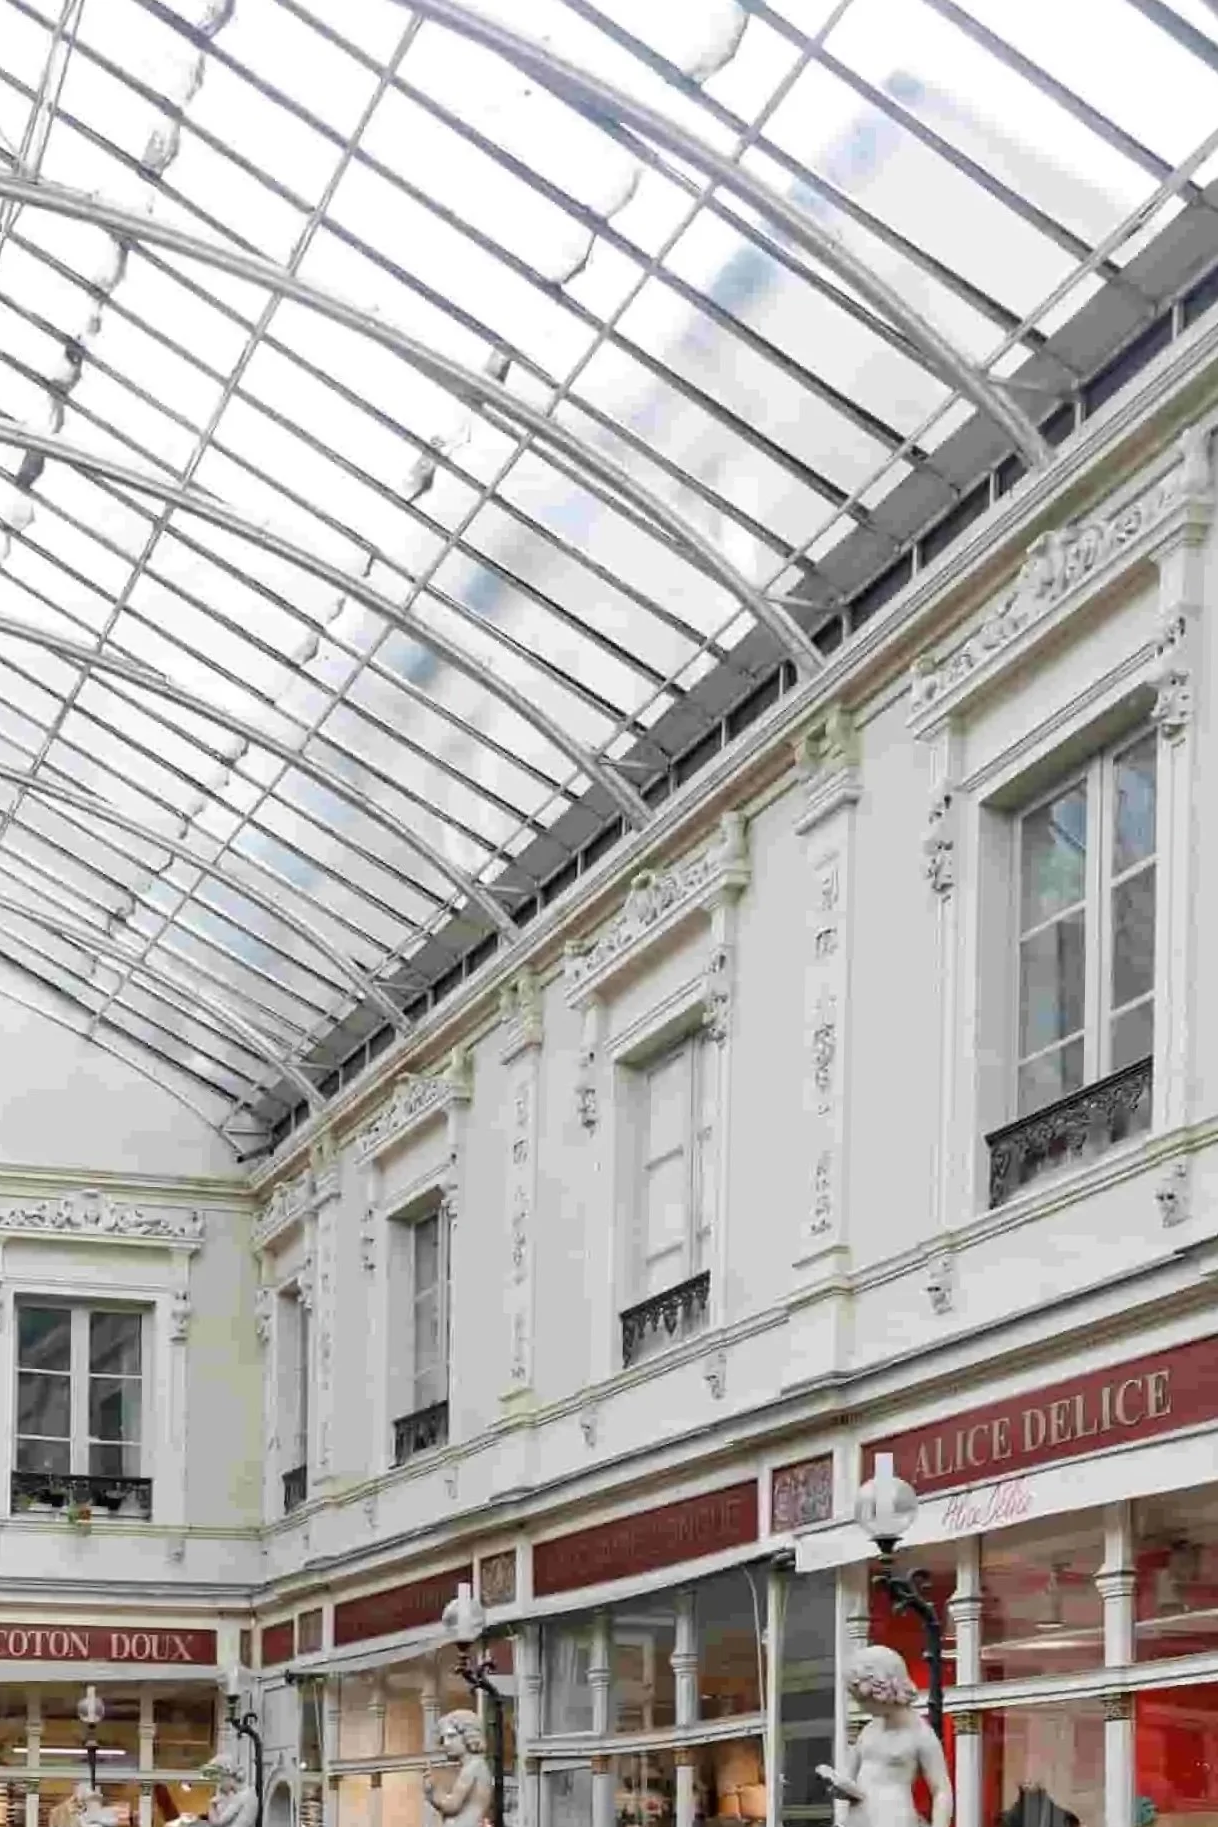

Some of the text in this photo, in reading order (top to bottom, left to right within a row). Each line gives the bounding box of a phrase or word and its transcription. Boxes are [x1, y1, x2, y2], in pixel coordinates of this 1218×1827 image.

[914, 1370, 1171, 1480] ALICE DELICE
[110, 1633, 194, 1660] DOUX
